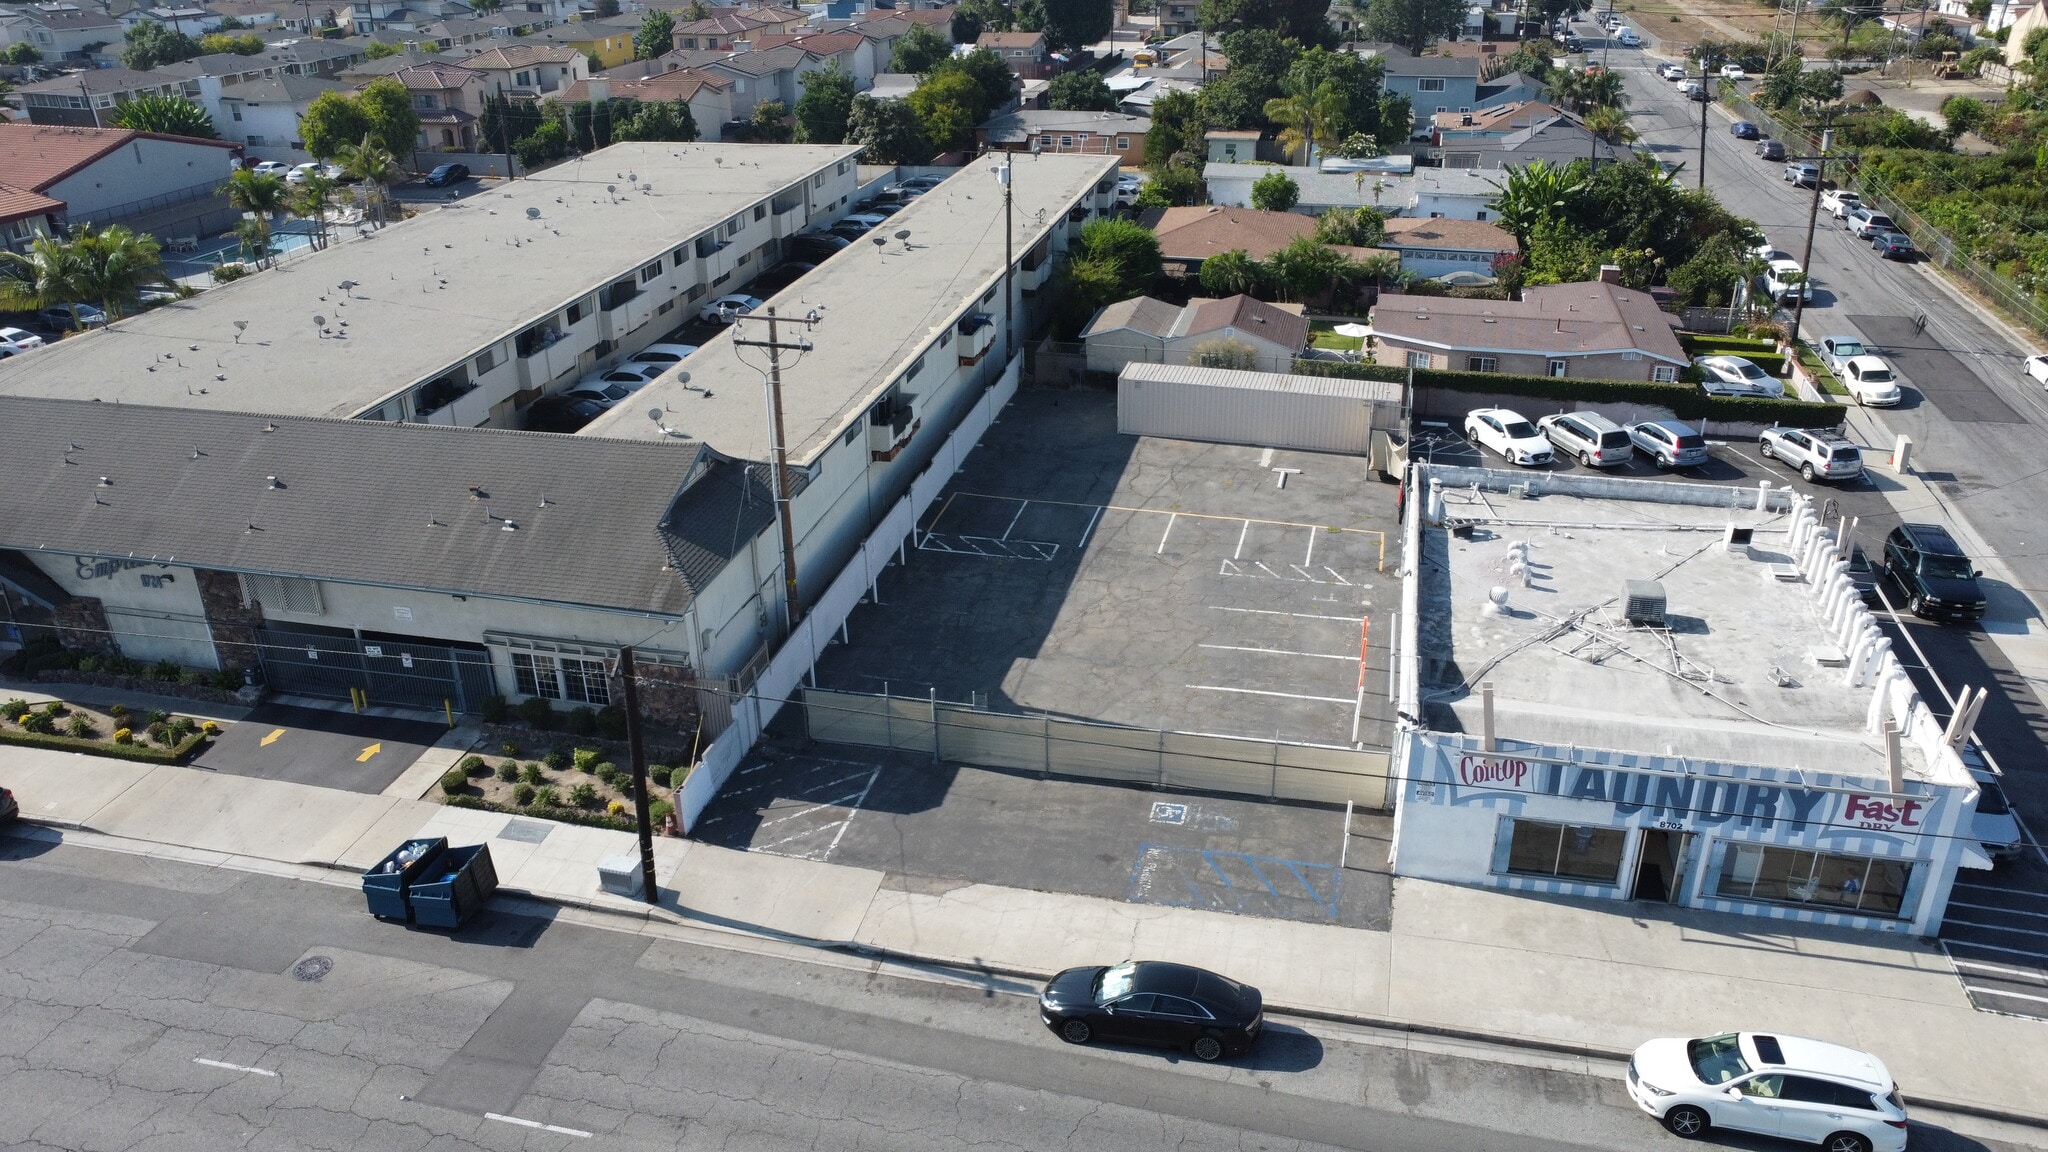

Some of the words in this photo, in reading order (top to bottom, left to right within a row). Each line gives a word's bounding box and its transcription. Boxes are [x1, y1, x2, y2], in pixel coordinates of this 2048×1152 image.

[1845, 794, 1922, 827] Fast
[1660, 821, 1683, 830] 8702
[1859, 821, 1896, 832] DRY
